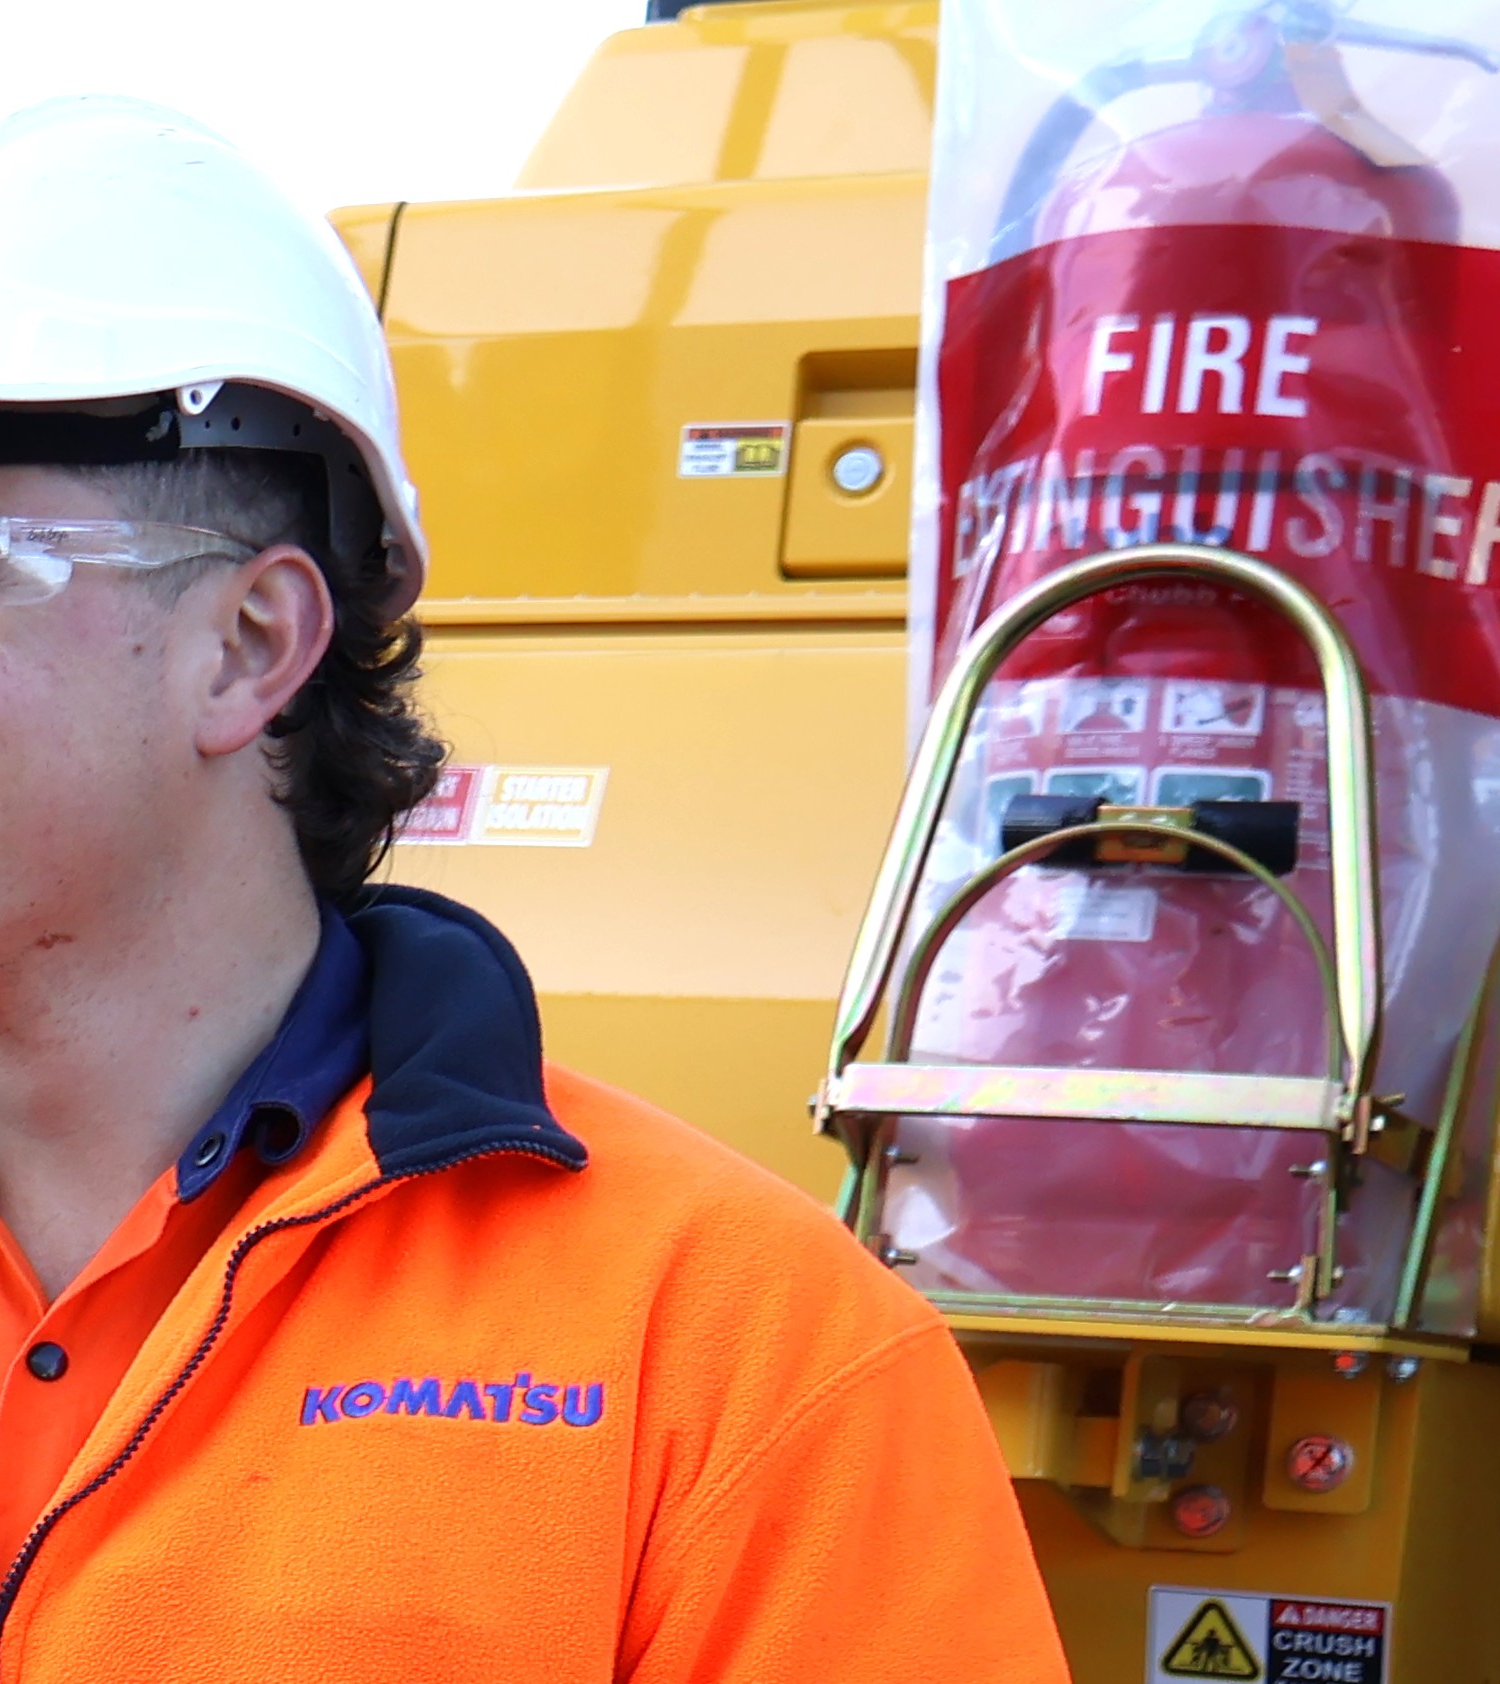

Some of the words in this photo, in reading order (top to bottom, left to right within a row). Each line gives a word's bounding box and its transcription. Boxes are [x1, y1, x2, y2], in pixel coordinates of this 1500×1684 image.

[1080, 313, 1319, 418] FIRE
[299, 1372, 603, 1427] KOMATSU
[1303, 1604, 1378, 1629] DANGER
[1273, 1630, 1375, 1657] CRUSH
[1281, 1656, 1363, 1683] ZONE
